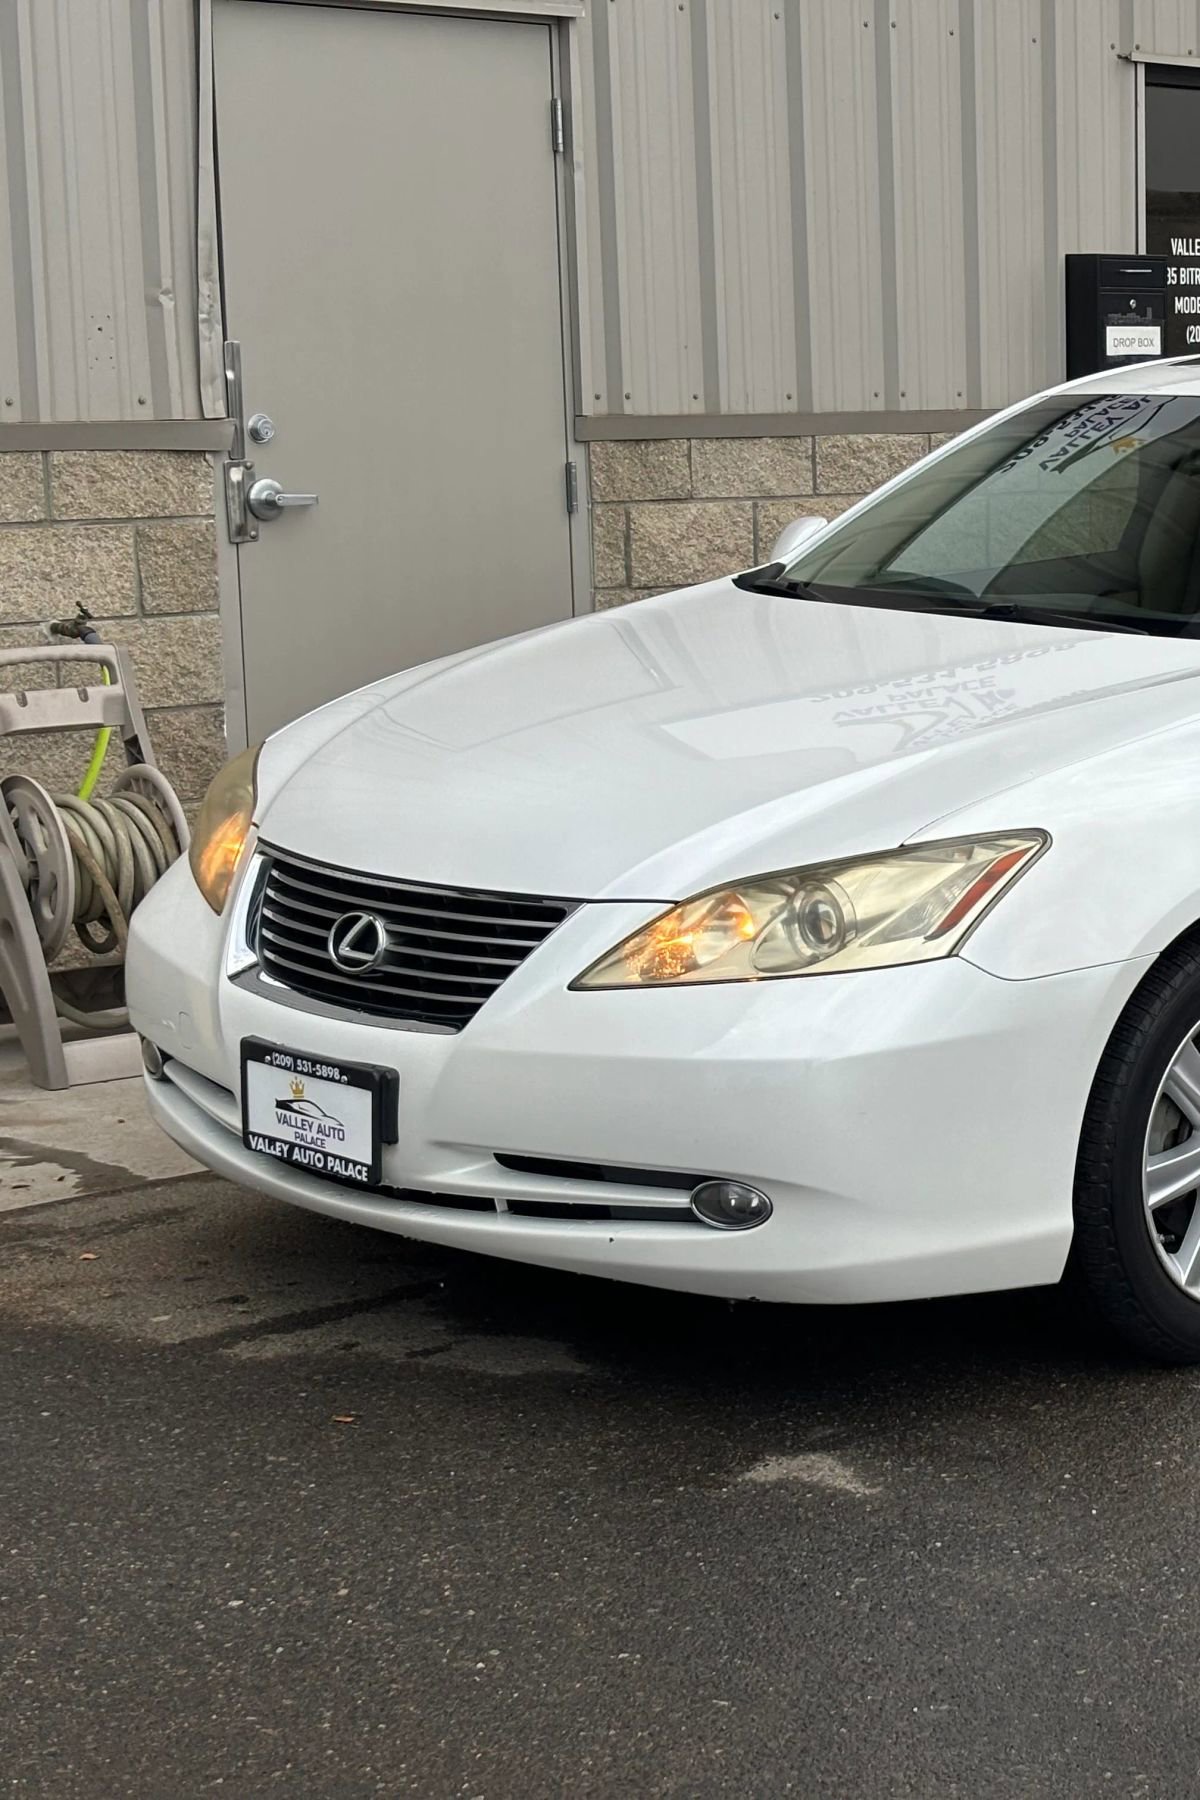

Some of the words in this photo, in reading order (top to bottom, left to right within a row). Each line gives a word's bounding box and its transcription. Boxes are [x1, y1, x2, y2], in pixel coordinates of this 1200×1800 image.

[1113, 337, 1136, 348] DROP
[1138, 337, 1155, 348] BOX
[272, 1051, 294, 1071] (209)
[297, 1059, 341, 1081] 531-5898
[275, 1111, 315, 1135] VALLEY
[317, 1123, 345, 1142] AUTO
[294, 1131, 327, 1149] PALACE
[249, 1134, 290, 1158] VALLEY
[292, 1148, 325, 1168] AUTO
[327, 1155, 368, 1182] PALACE
